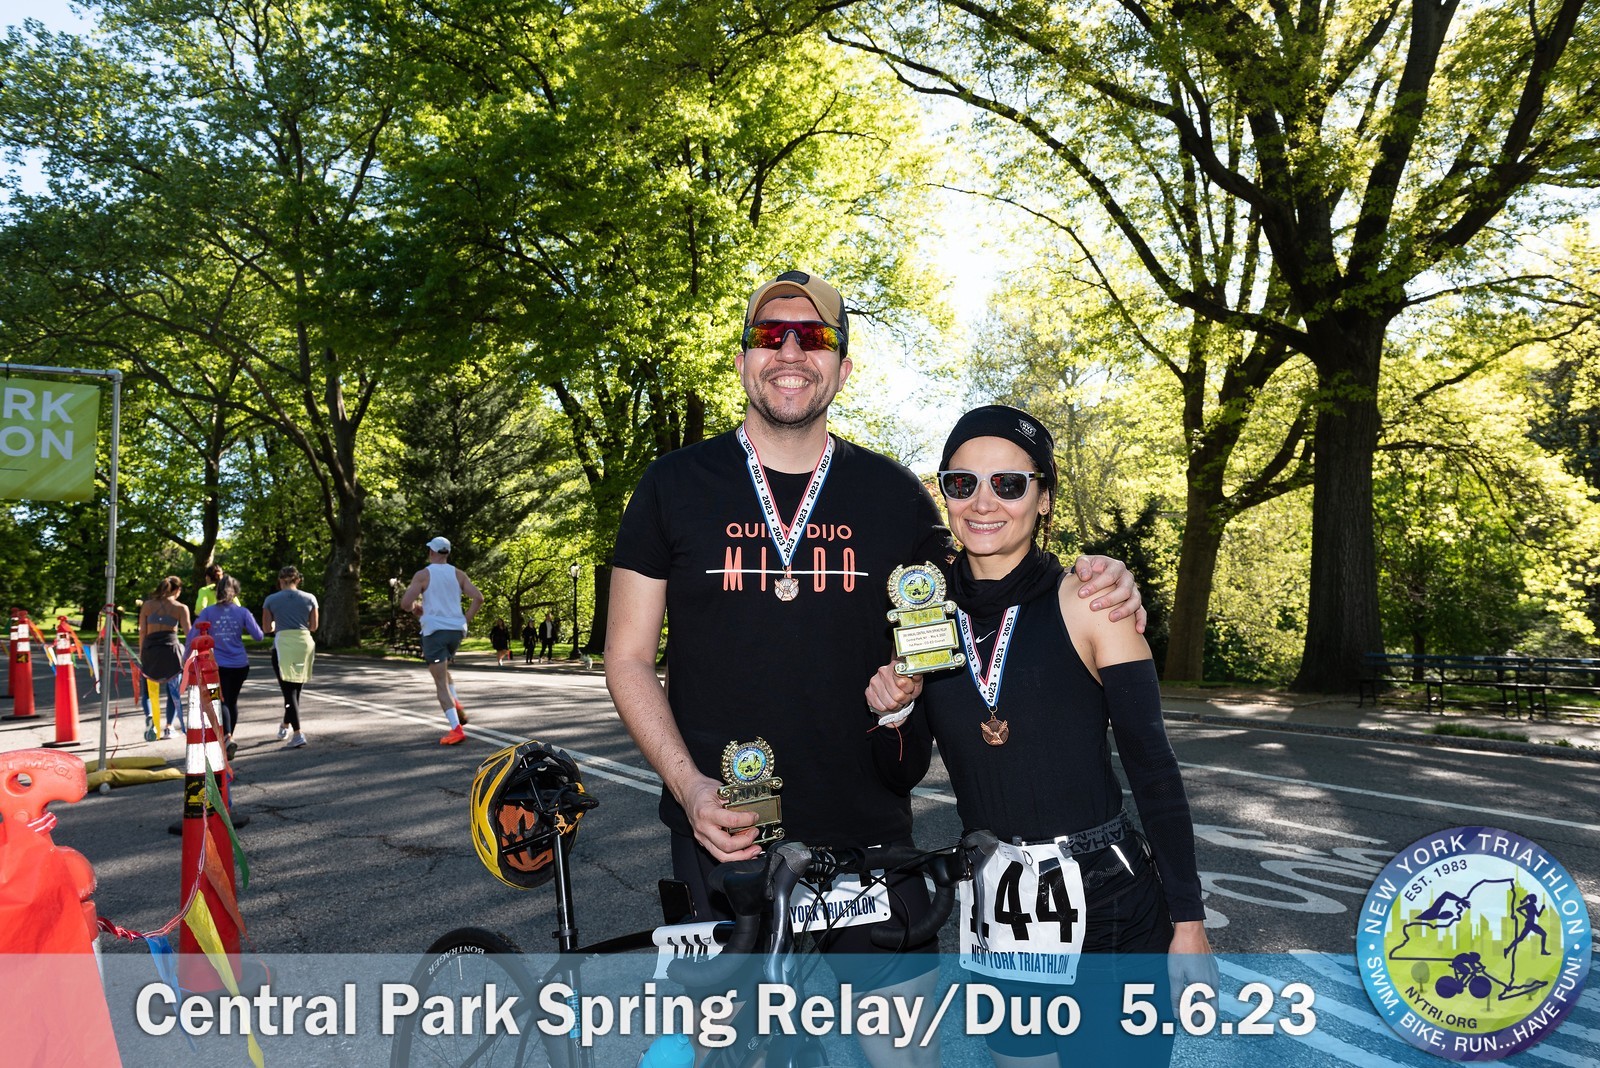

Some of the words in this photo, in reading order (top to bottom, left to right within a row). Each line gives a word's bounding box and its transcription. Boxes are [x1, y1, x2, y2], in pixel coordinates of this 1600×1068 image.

[751, 463, 764, 485] 2023
[762, 494, 774, 516] 2023
[772, 525, 785, 546] 2023
[784, 537, 795, 559] 2023
[796, 508, 808, 528] 2023
[808, 480, 820, 500] 2023
[818, 454, 831, 474] 2023
[725, 522, 790, 538] QUI
[806, 523, 852, 542] DIJO
[966, 642, 976, 662] 2023
[993, 647, 1005, 669] 2023
[1002, 617, 1014, 637] 2023
[789, 905, 819, 924] YORK
[822, 896, 877, 920] TRIATHLON
[428, 945, 485, 975] BONTRAGER
[971, 944, 987, 966] NEW
[987, 950, 1016, 971] YORK
[1017, 952, 1070, 974] TRIATHLON
